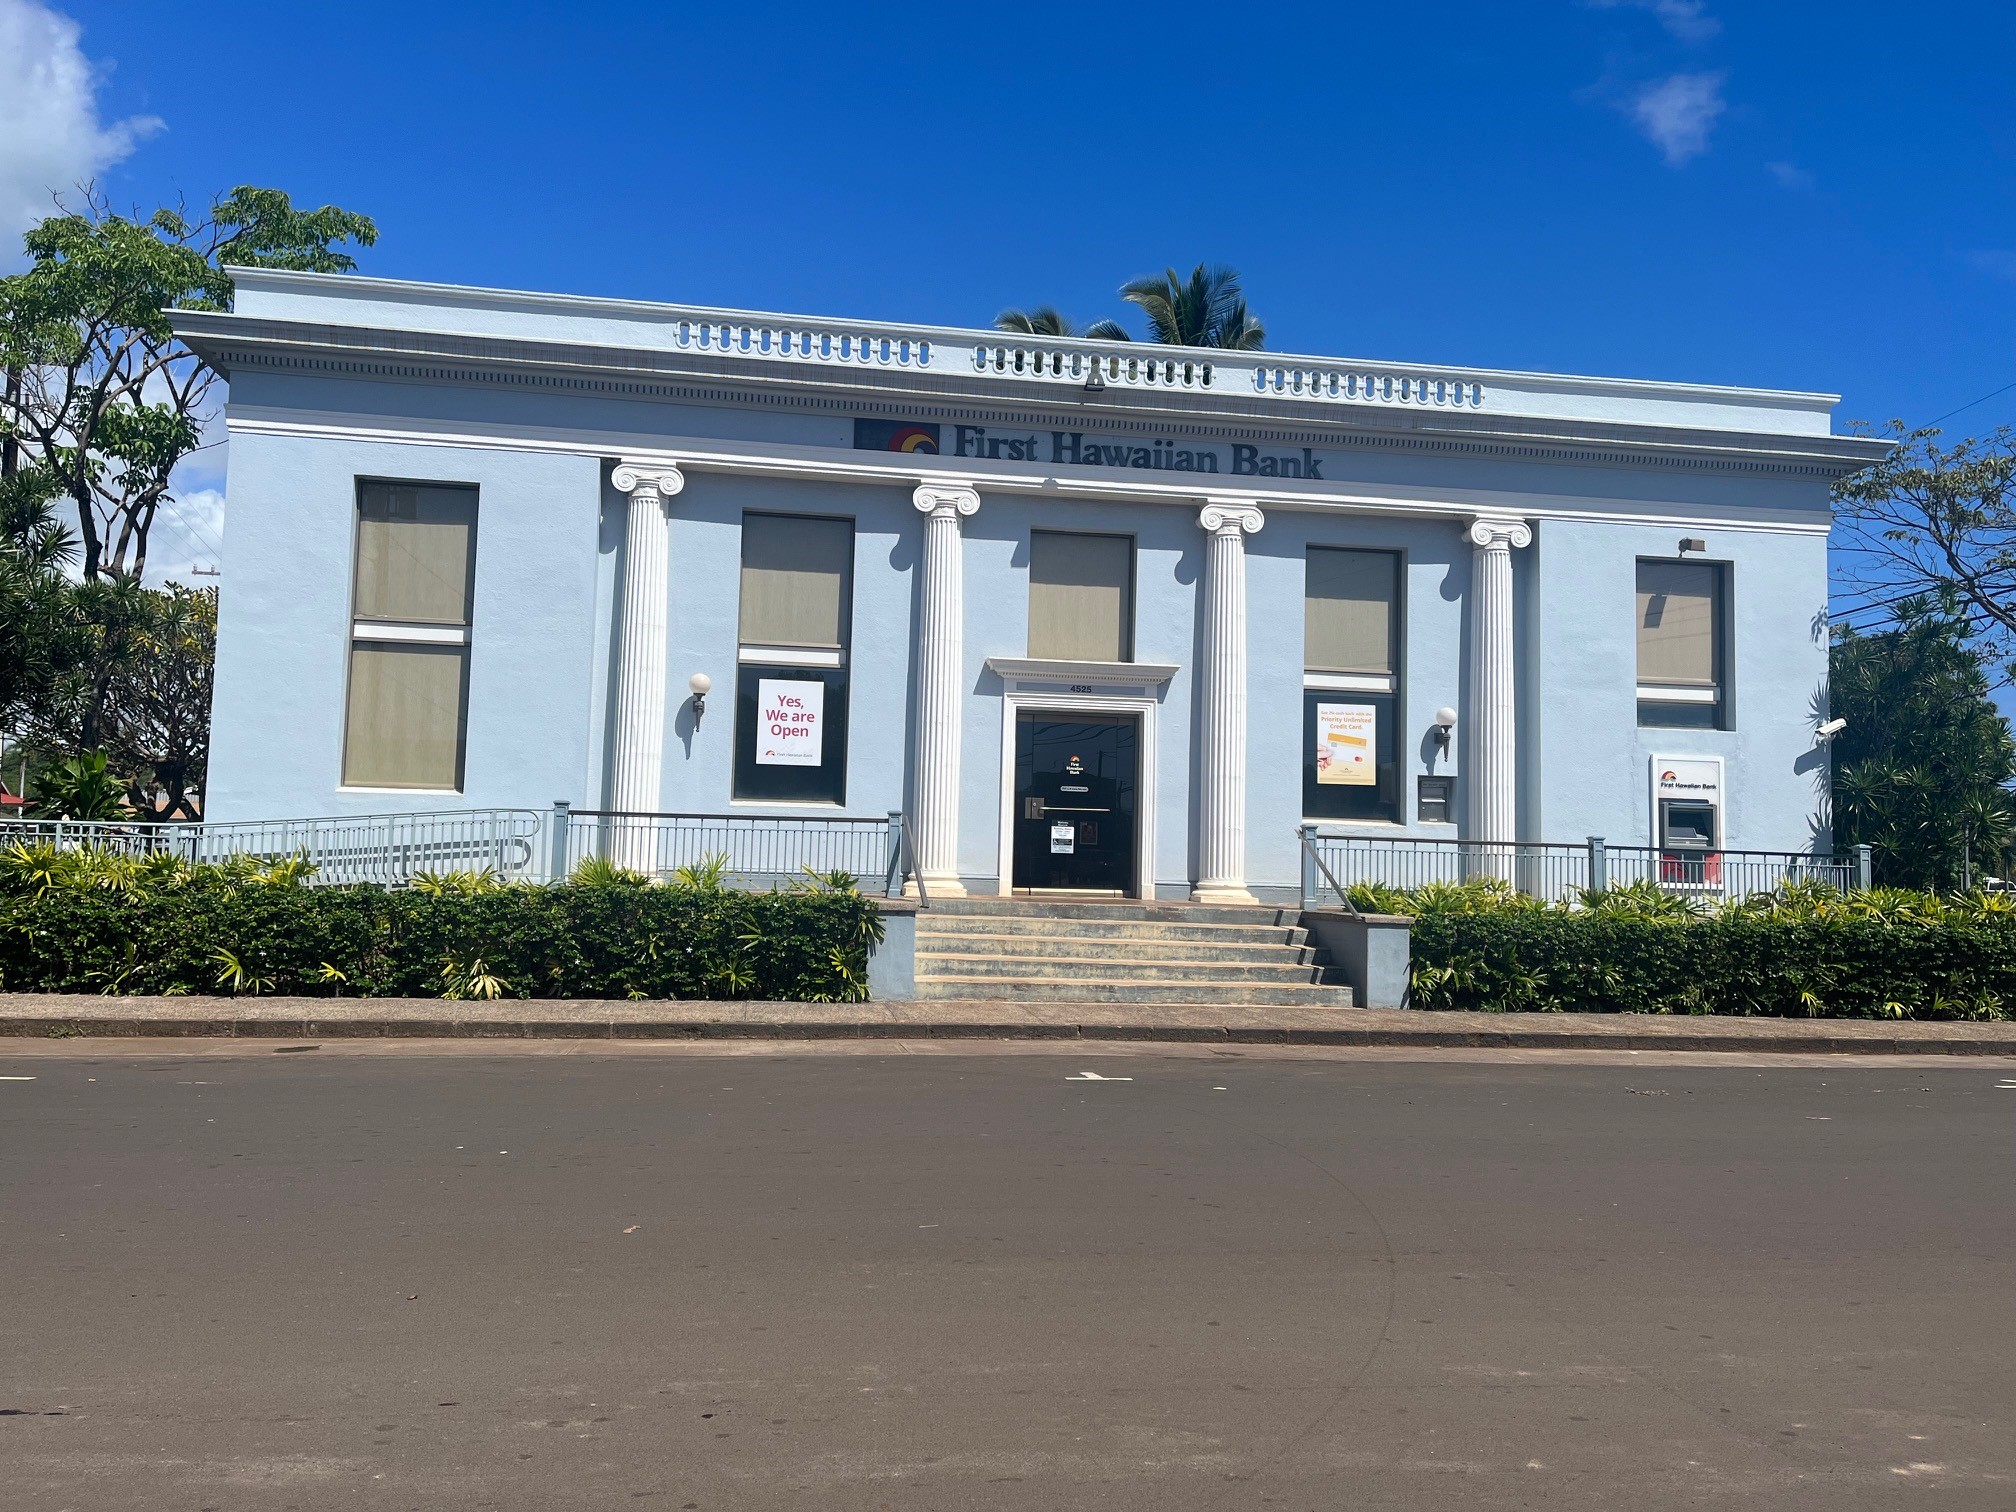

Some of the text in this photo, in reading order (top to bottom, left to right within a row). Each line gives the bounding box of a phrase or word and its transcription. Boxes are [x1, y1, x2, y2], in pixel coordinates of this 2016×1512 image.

[953, 425, 1324, 480] First Hawaiian Bank
[1070, 685, 1092, 693] 4525
[777, 695, 804, 709] Yes,
[766, 709, 815, 723] We are
[771, 724, 809, 740] Open
